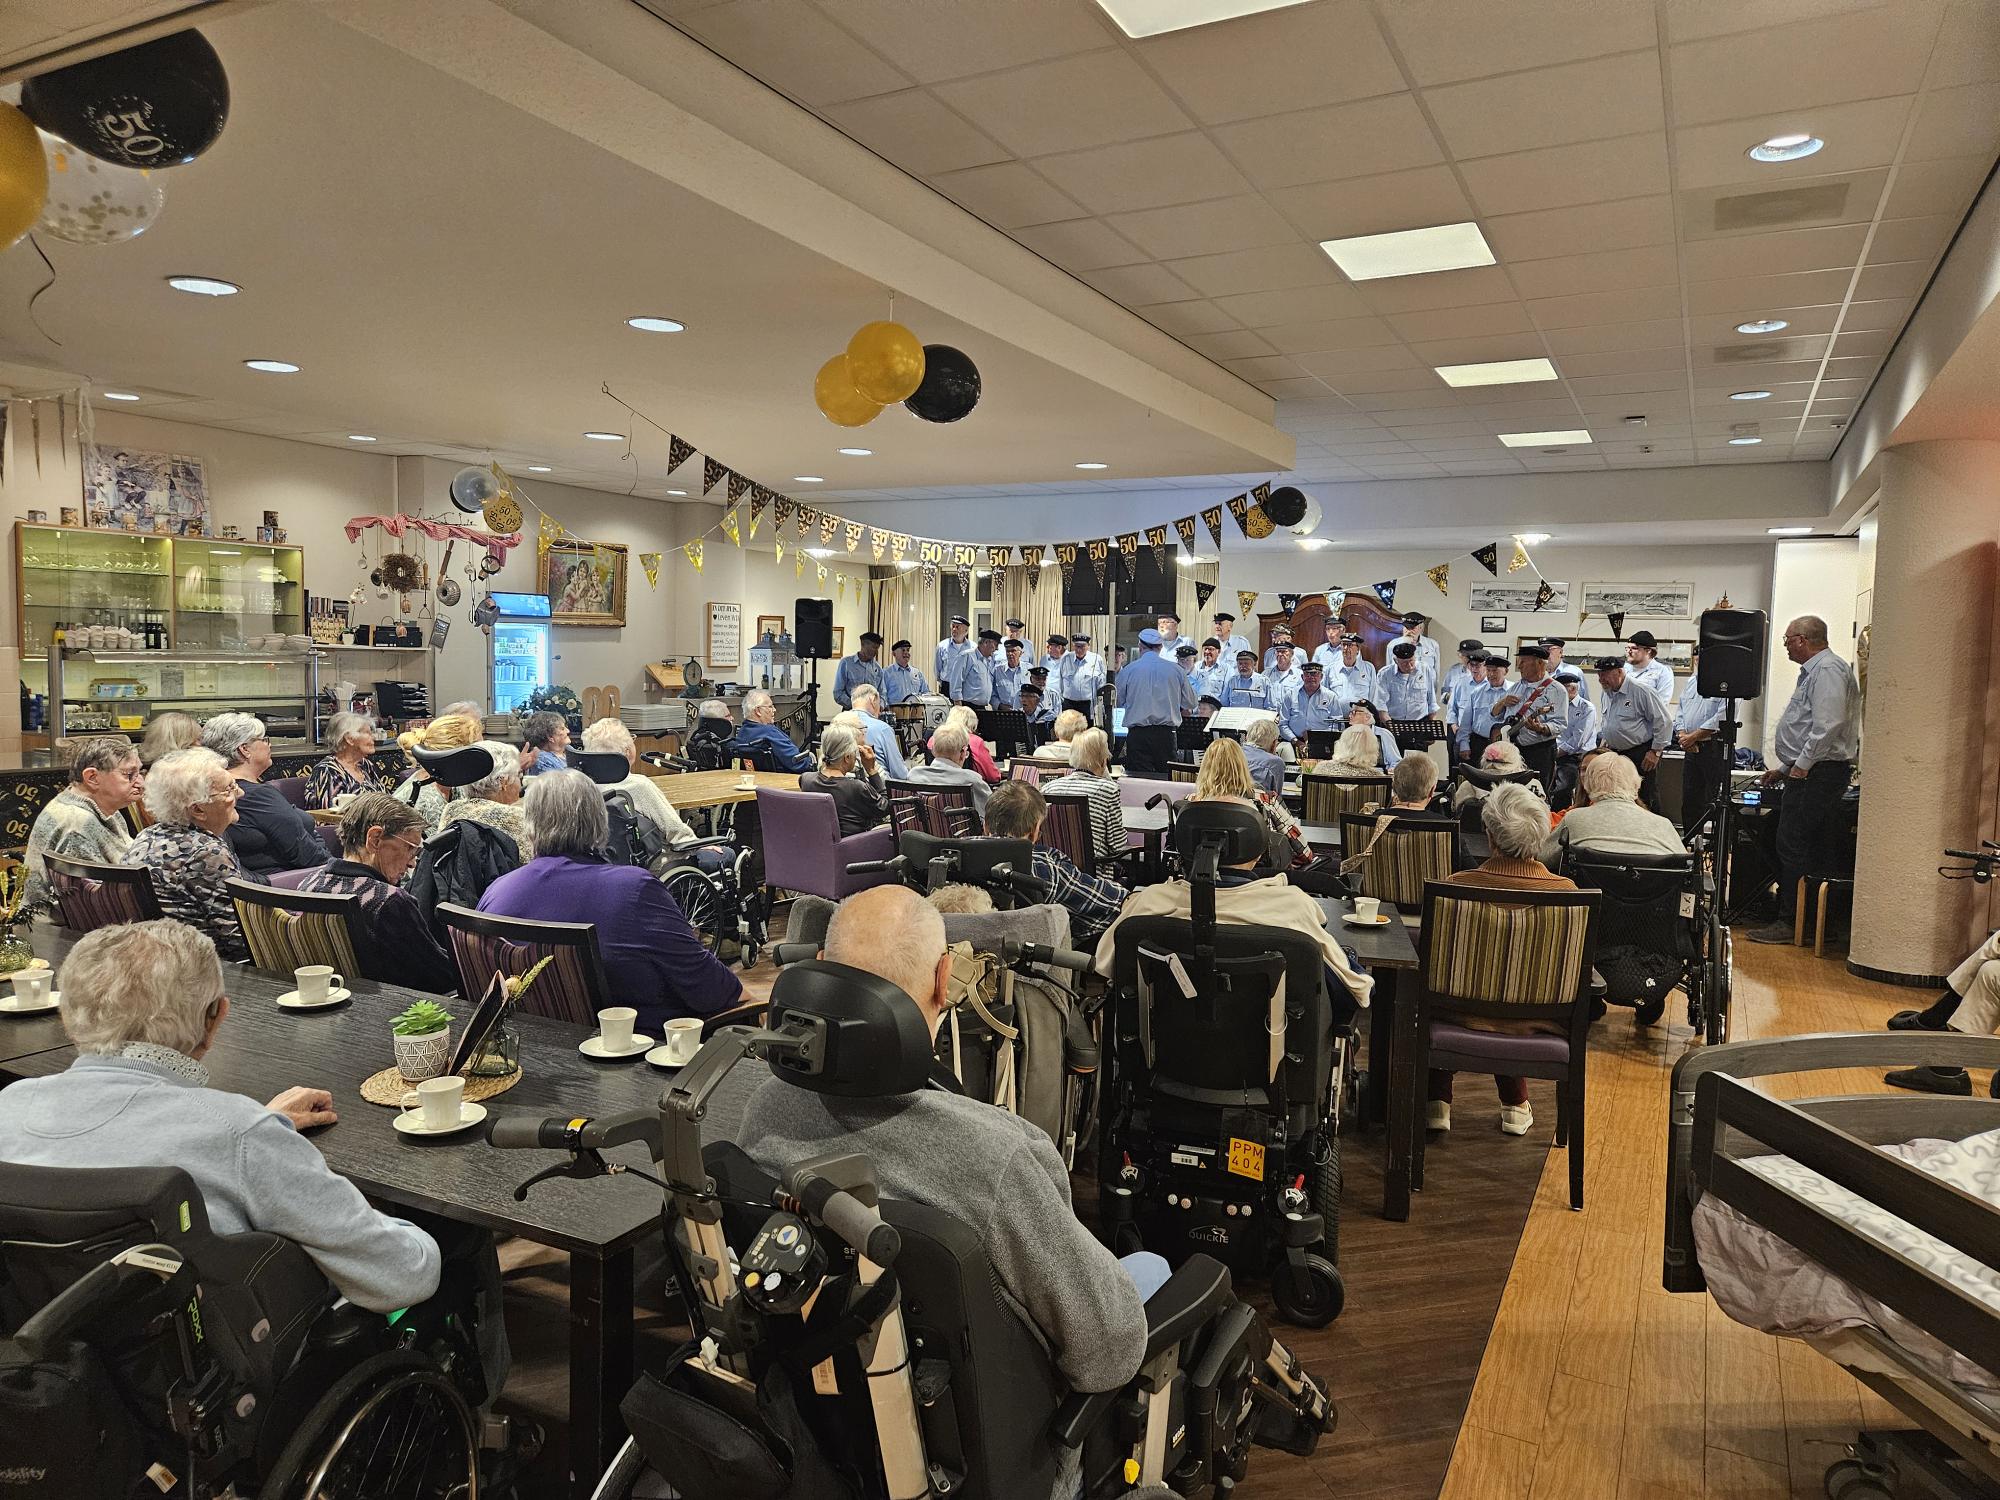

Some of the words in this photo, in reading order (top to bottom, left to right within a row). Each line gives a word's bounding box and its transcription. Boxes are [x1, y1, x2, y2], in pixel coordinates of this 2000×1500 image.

[104, 112, 164, 156] 50
[1255, 485, 1270, 505] 50
[500, 506, 511, 516] 50
[1231, 497, 1247, 517] 50
[799, 509, 816, 525] 50
[821, 517, 838, 533] 50
[1206, 509, 1221, 528] 50
[1248, 519, 1258, 527] 50
[846, 524, 861, 540] 50
[1178, 519, 1195, 539] 50
[872, 532, 888, 547] 50
[891, 536, 907, 551] 50
[1120, 535, 1138, 555] 50
[1149, 528, 1166, 548] 50
[920, 541, 941, 563] 50
[954, 546, 976, 566] 50
[989, 548, 1009, 567] 50
[1024, 548, 1041, 566] 50
[1058, 545, 1076, 564] 50
[1089, 541, 1108, 561] 50
[1484, 552, 1495, 563] 50
[1436, 571, 1447, 582] 50
[1199, 589, 1210, 599] 50
[1242, 597, 1253, 607] 50
[1285, 600, 1295, 609] 50
[1613, 620, 1622, 629] 50
[687, 704, 698, 719] 50
[794, 709, 804, 722] 50
[781, 717, 791, 730] 50
[296, 764, 313, 778] 50
[379, 774, 396, 790] 50
[15, 783, 39, 802] 50
[6, 819, 29, 838] 50
[1233, 1141, 1263, 1159] PPM
[1231, 1155, 1261, 1172] 404
[1188, 1230, 1229, 1244] QUICKIE
